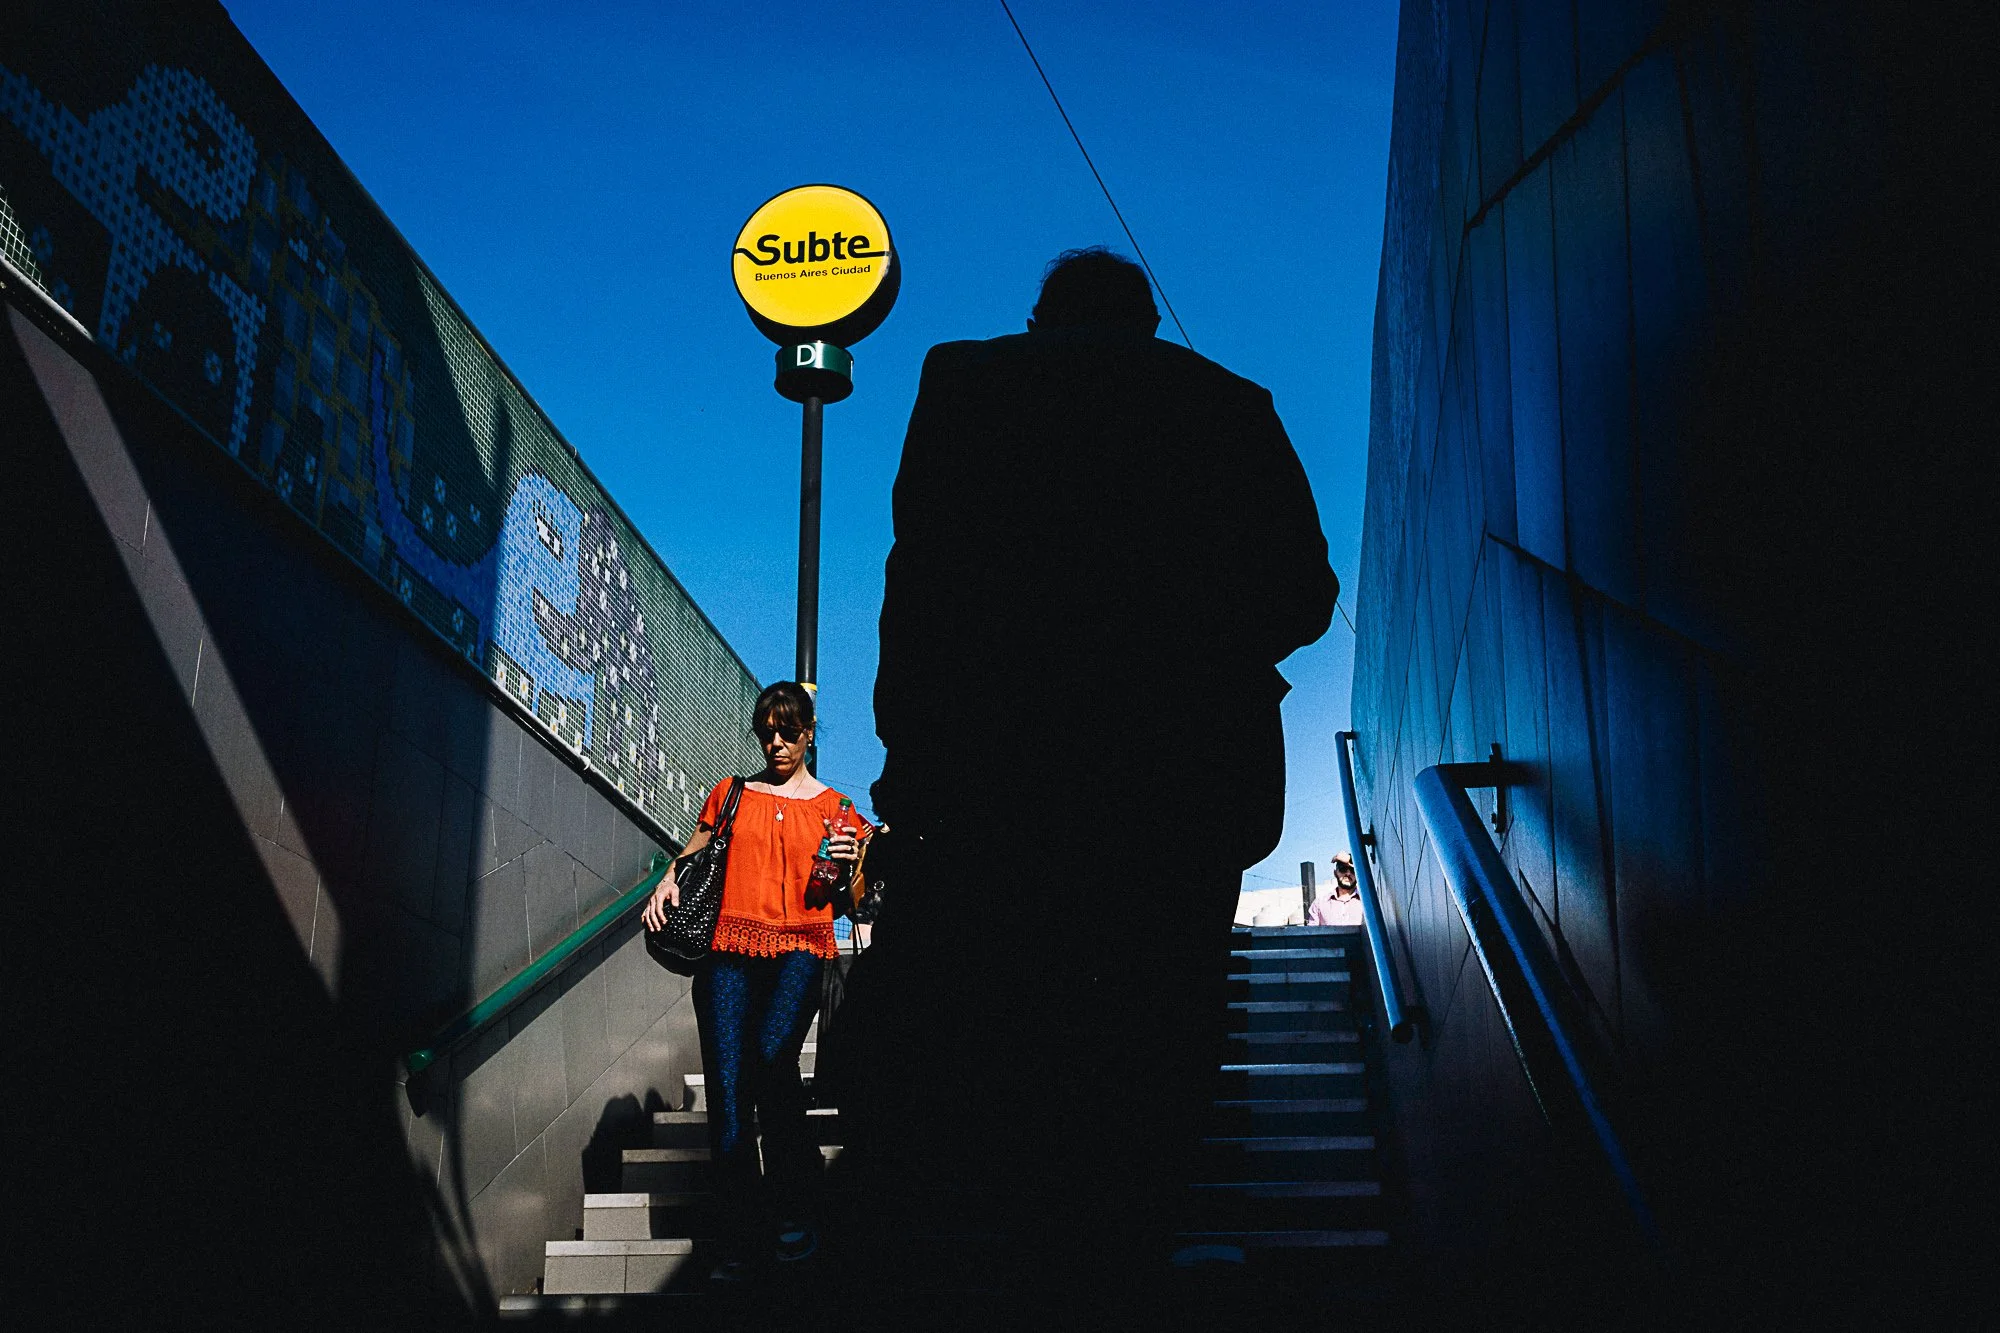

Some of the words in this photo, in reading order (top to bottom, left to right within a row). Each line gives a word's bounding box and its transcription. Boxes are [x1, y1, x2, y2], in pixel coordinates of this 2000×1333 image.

[756, 231, 874, 266] Subte
[755, 272, 796, 281] Buenos
[799, 269, 828, 278] Aires
[831, 265, 871, 276] Ciudad
